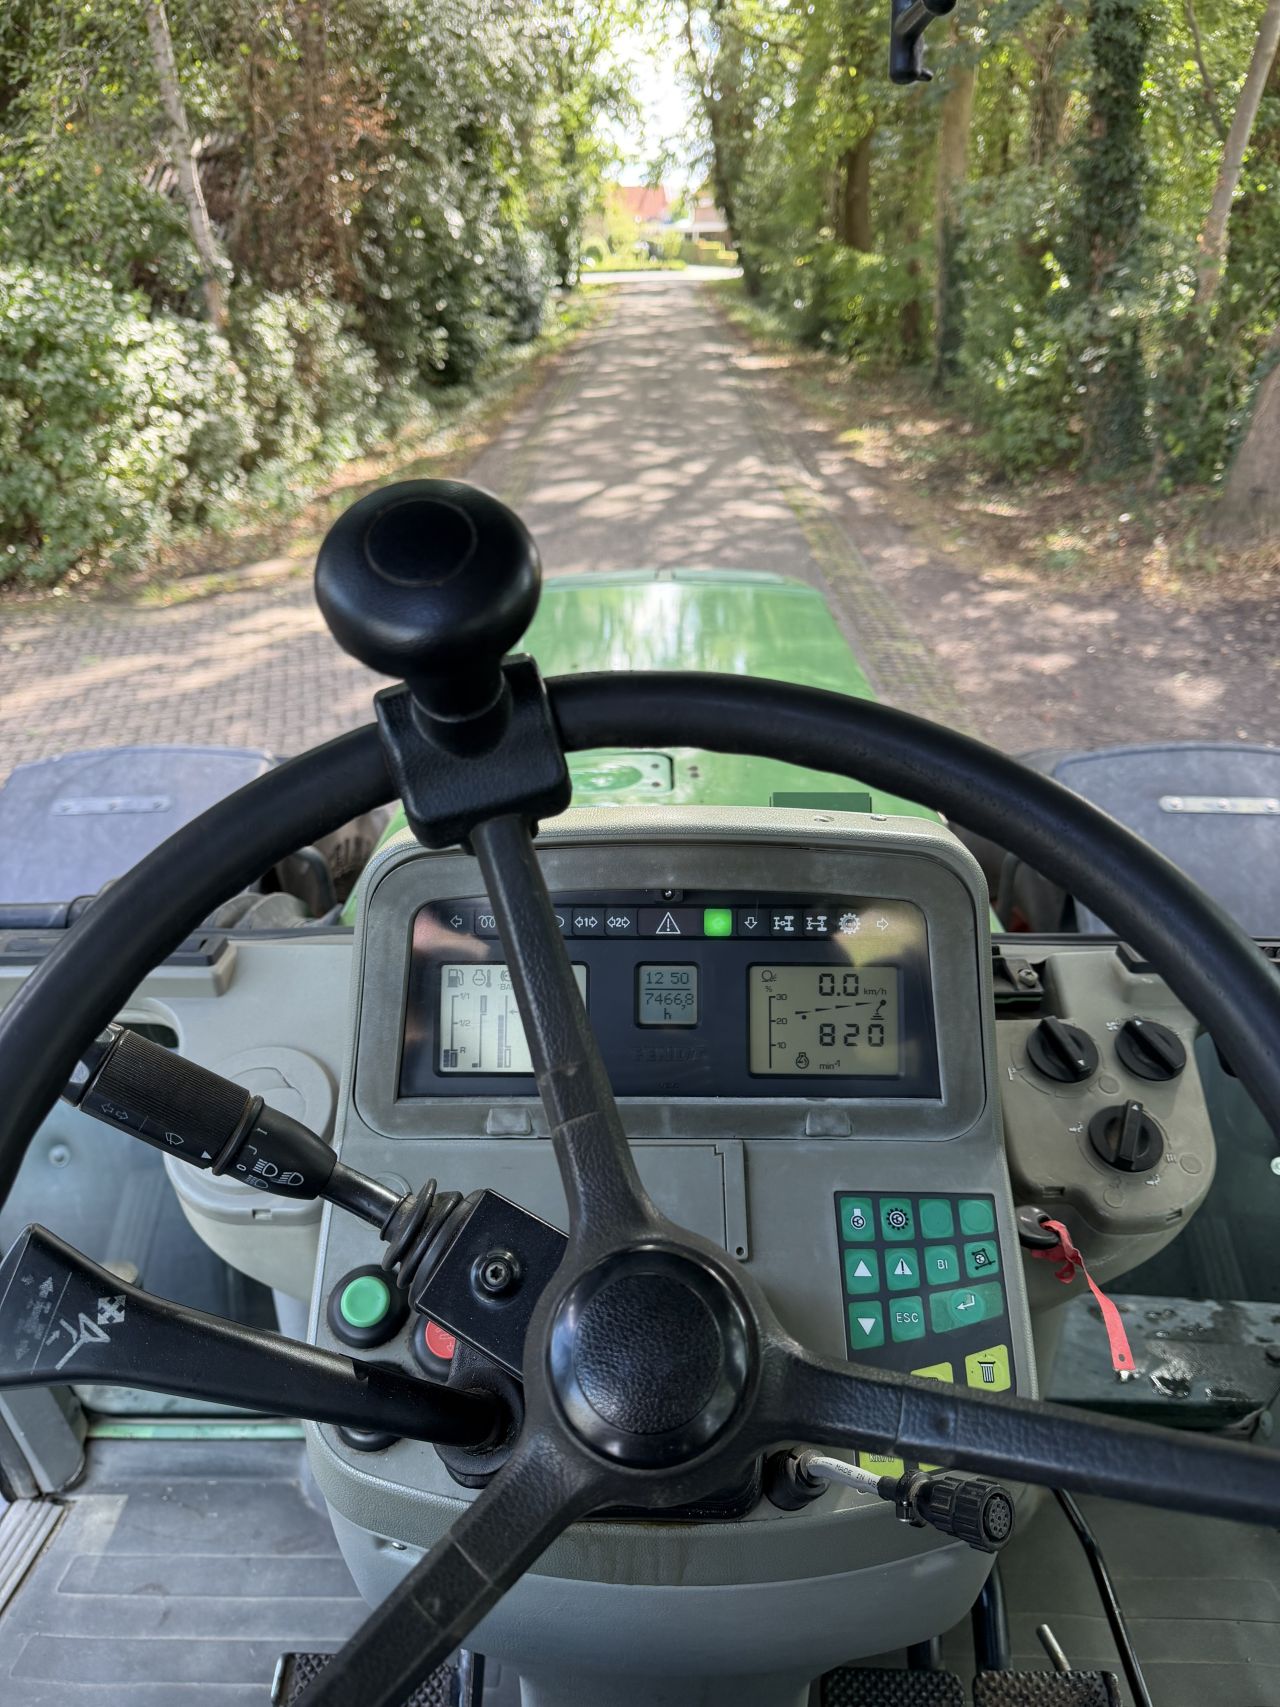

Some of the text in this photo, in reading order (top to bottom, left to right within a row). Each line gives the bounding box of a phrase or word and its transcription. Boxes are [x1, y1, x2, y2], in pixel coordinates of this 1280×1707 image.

[646, 971, 690, 985] 12 50
[818, 973, 887, 997] 0.0 km/h
[776, 993, 788, 1001] 30
[663, 1007, 672, 1020] h
[459, 1019, 471, 1027] 1/2
[776, 1017, 788, 1025] 20
[819, 1023, 885, 1048] 820
[459, 1046, 467, 1054] R
[776, 1041, 787, 1050] 10
[895, 1312, 919, 1323] ESC
[835, 1464, 853, 1476] MADE
